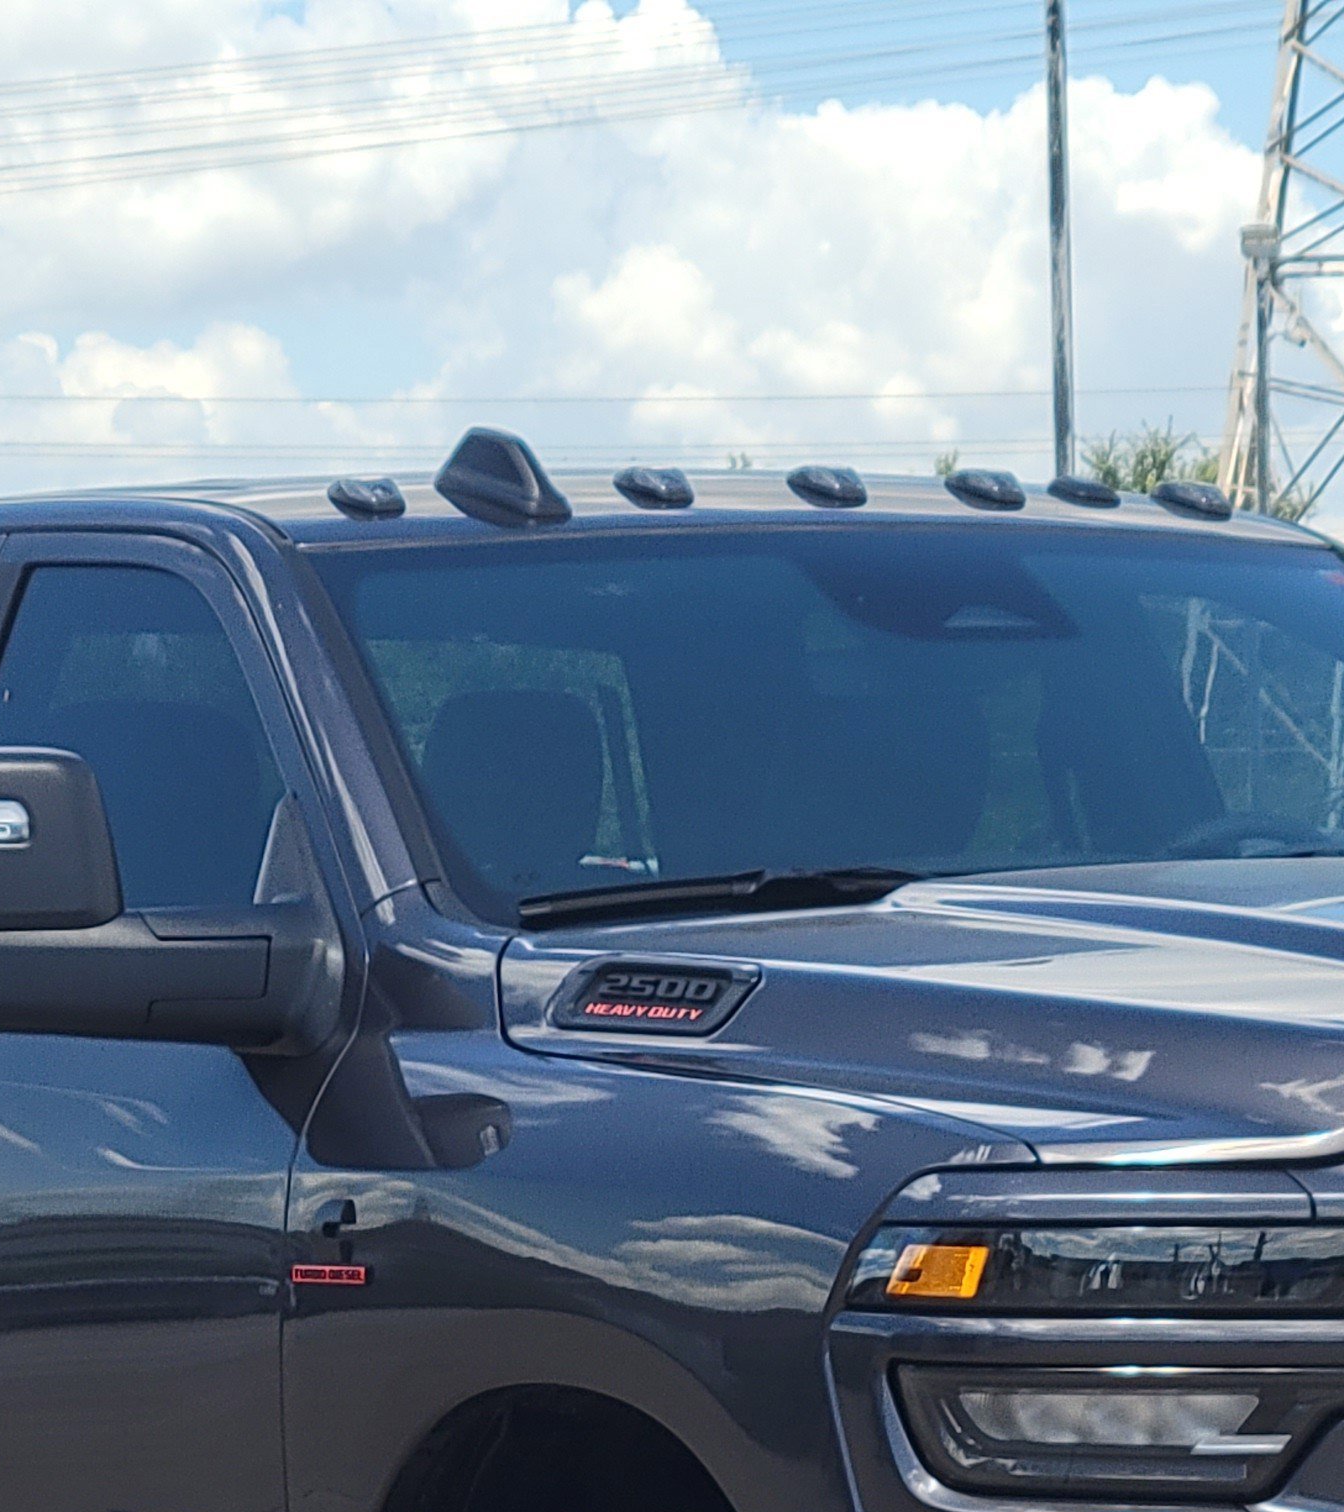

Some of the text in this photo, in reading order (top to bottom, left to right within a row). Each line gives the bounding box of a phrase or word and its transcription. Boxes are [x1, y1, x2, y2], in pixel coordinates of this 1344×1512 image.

[599, 975, 717, 1000] 2500
[585, 1002, 703, 1020] HEAVY DUTY
